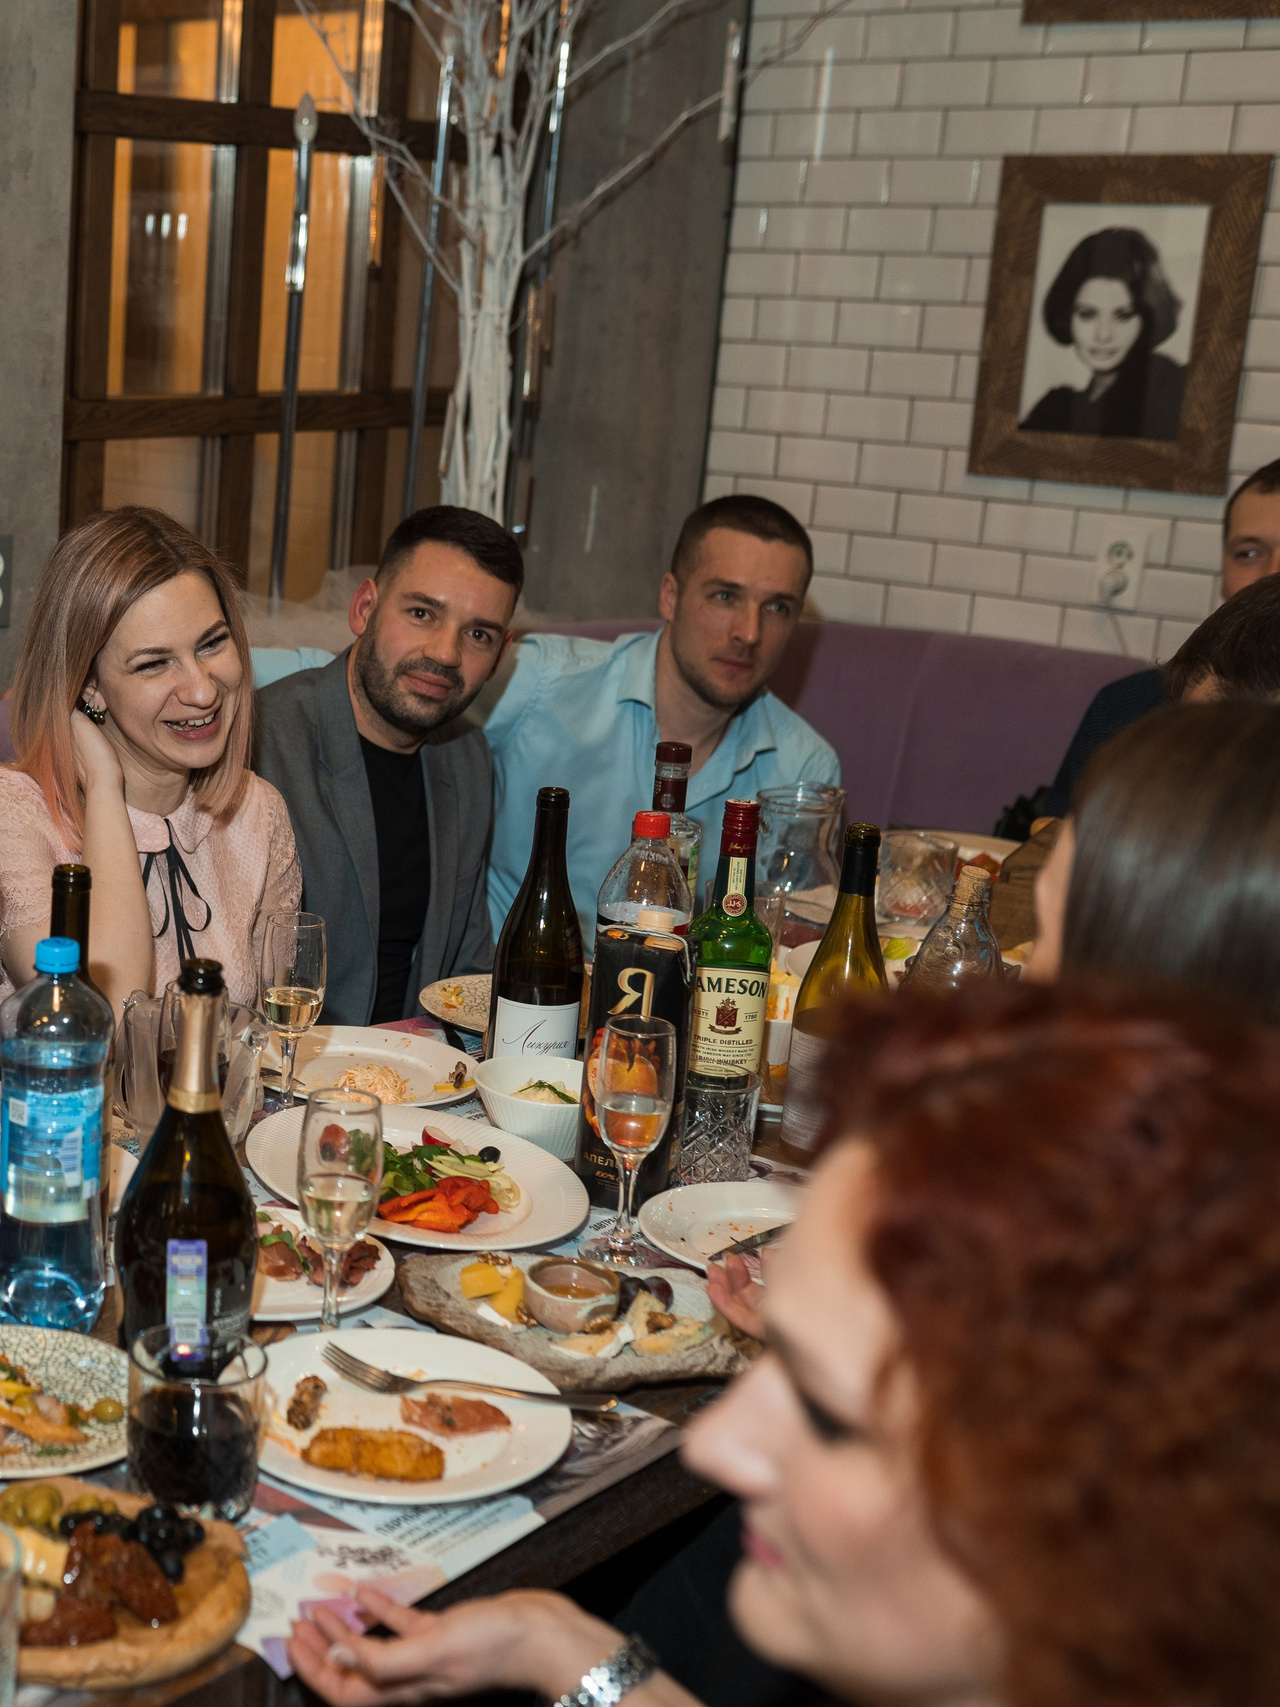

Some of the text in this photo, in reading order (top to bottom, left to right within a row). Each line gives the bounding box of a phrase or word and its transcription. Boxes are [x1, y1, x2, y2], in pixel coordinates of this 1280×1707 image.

[607, 967, 655, 1023] Я
[696, 977, 767, 998] AMESON
[693, 1034, 718, 1044] TRIPLE
